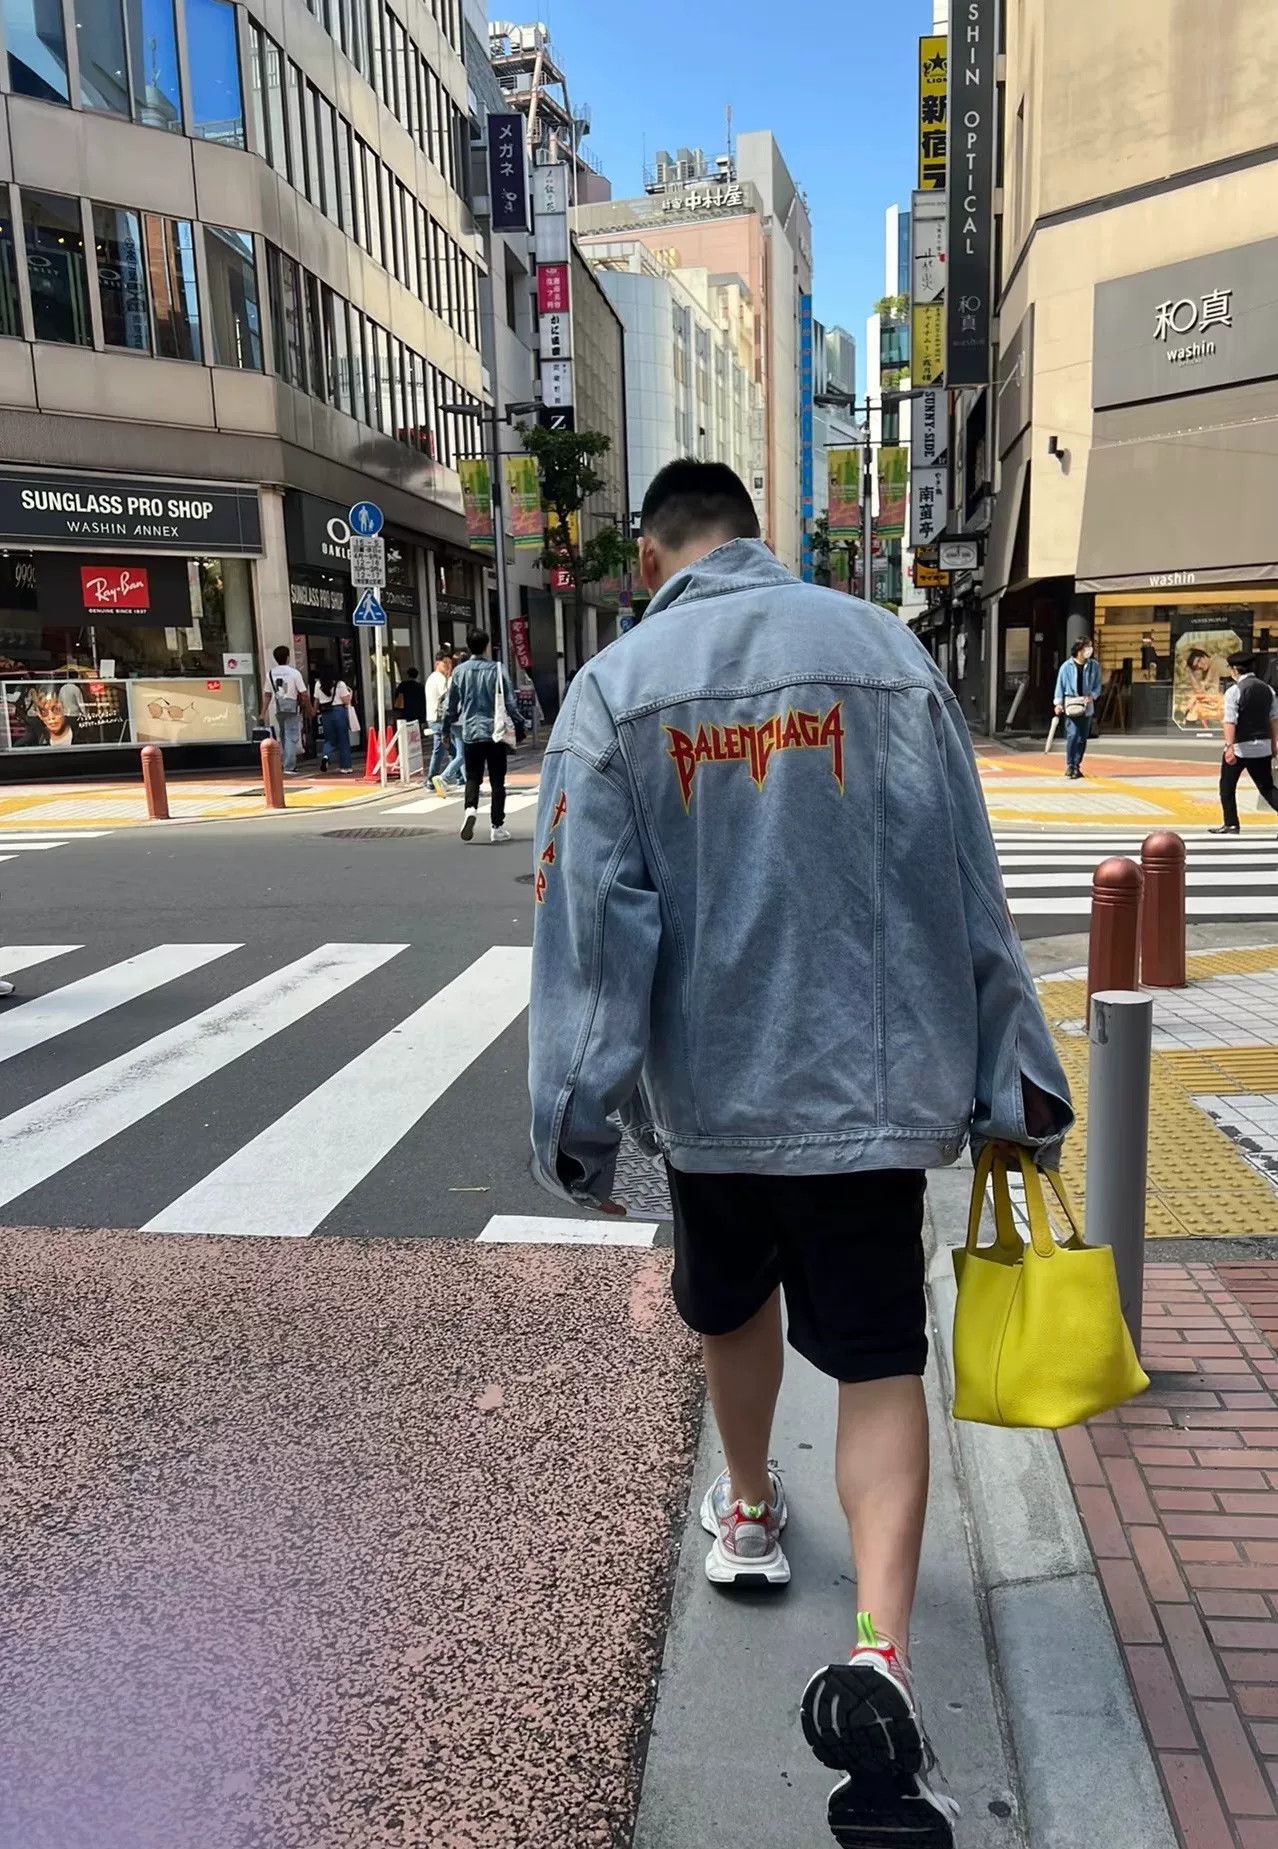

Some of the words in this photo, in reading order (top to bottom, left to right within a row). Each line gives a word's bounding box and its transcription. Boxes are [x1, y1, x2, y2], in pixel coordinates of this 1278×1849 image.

[499, 124, 515, 177] メガネ
[962, 110, 981, 255] OPTICAL
[1153, 288, 1232, 341] 和真
[1166, 340, 1215, 361] washin
[21, 489, 123, 516] SUNGLASS
[128, 497, 163, 517] PRO
[168, 500, 213, 520] SHOP
[67, 521, 127, 535] WASHIN
[133, 523, 180, 537] ANNEX
[321, 542, 352, 560] OAKLE
[86, 570, 145, 602] Ray-Ban
[291, 583, 319, 607] SUNGLASS
[1150, 572, 1196, 587] washin
[661, 701, 845, 815] BALENCIAGA
